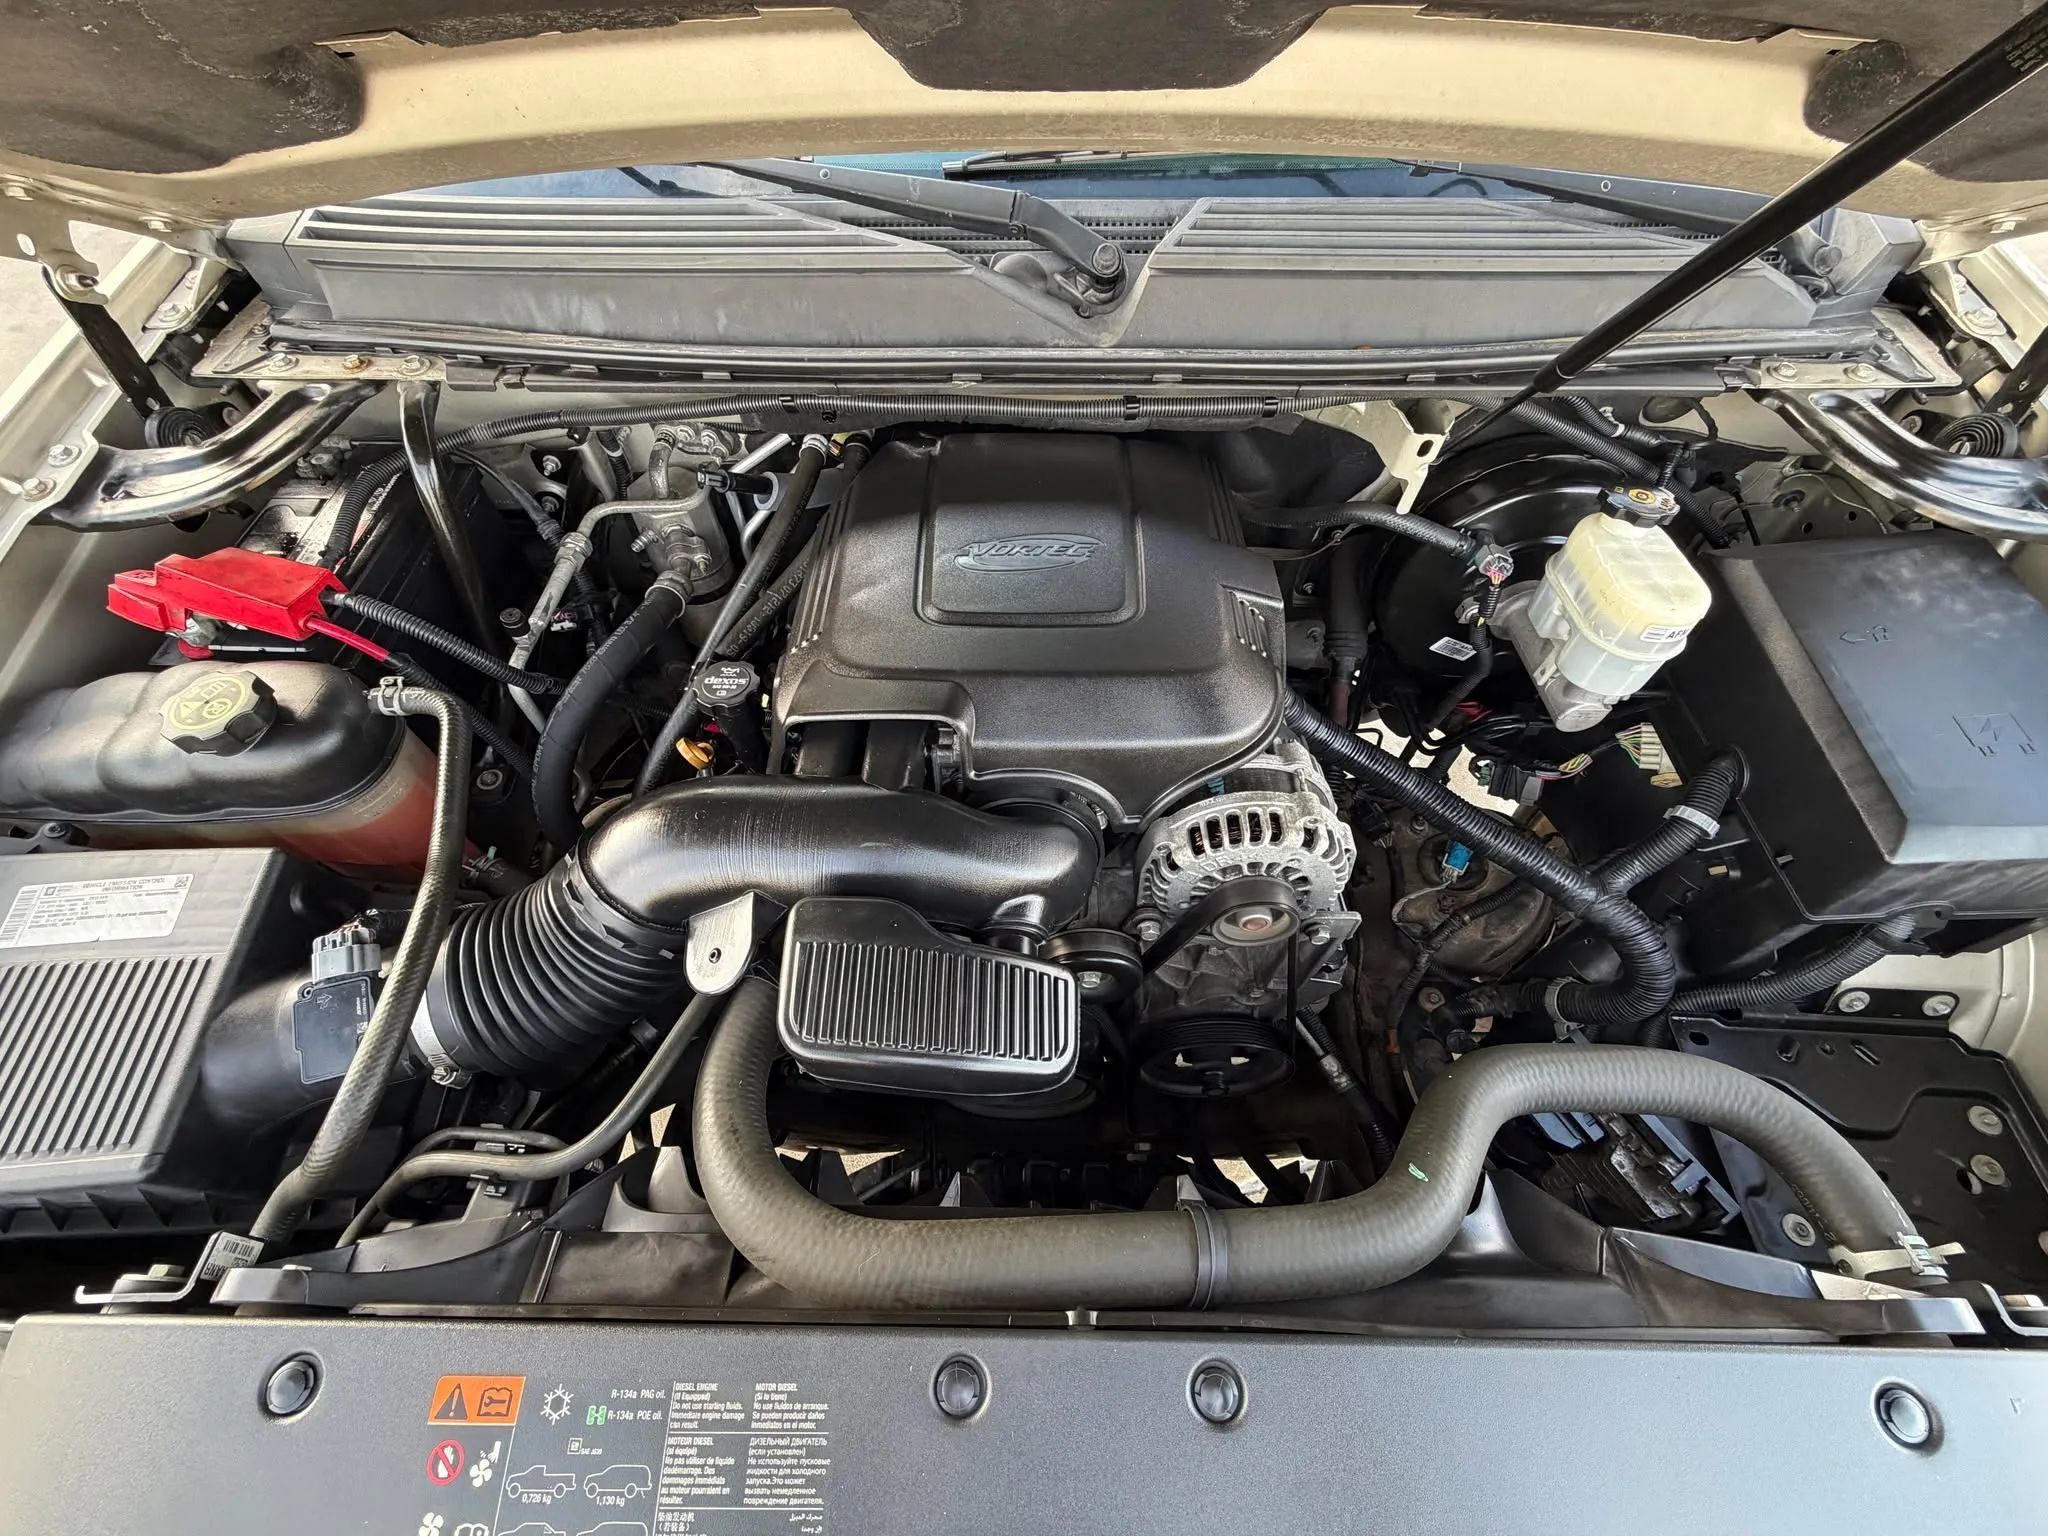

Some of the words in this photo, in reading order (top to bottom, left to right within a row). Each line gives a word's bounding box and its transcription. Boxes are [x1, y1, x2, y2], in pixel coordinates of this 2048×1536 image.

[960, 541, 1096, 558] VORTEC
[704, 676, 747, 684] dexos
[676, 1382, 696, 1390] DIESEL
[696, 1382, 718, 1391] ENGINE
[756, 1383, 777, 1391] MOTOR
[778, 1383, 798, 1391] DIESEL
[611, 1389, 638, 1398] R-134a
[640, 1389, 654, 1398] PAG
[656, 1390, 666, 1398] oil.
[703, 1402, 725, 1411] starting
[802, 1403, 829, 1411] arranque.
[608, 1410, 634, 1420] R-134a
[637, 1410, 652, 1420] POE
[652, 1411, 663, 1420] oil.
[702, 1412, 721, 1420] engine
[722, 1412, 745, 1421] damage
[752, 1411, 760, 1419] Se
[761, 1411, 782, 1420] pueden
[783, 1411, 807, 1420] producir
[668, 1437, 692, 1445] MOTEUR
[693, 1437, 714, 1445] DIESEL
[750, 1436, 790, 1446] ДИЗЕЛЬНЫЙ
[791, 1437, 828, 1446] ДВИГАТЕЛЬ
[715, 1457, 735, 1466] liquide
[758, 1457, 798, 1466] используйте
[662, 1476, 694, 1486] dommages
[691, 1486, 721, 1496] pourraient
[522, 1494, 542, 1504] 0,726
[542, 1494, 552, 1504] kg
[596, 1496, 616, 1506] 1,130
[616, 1496, 625, 1507] kg
